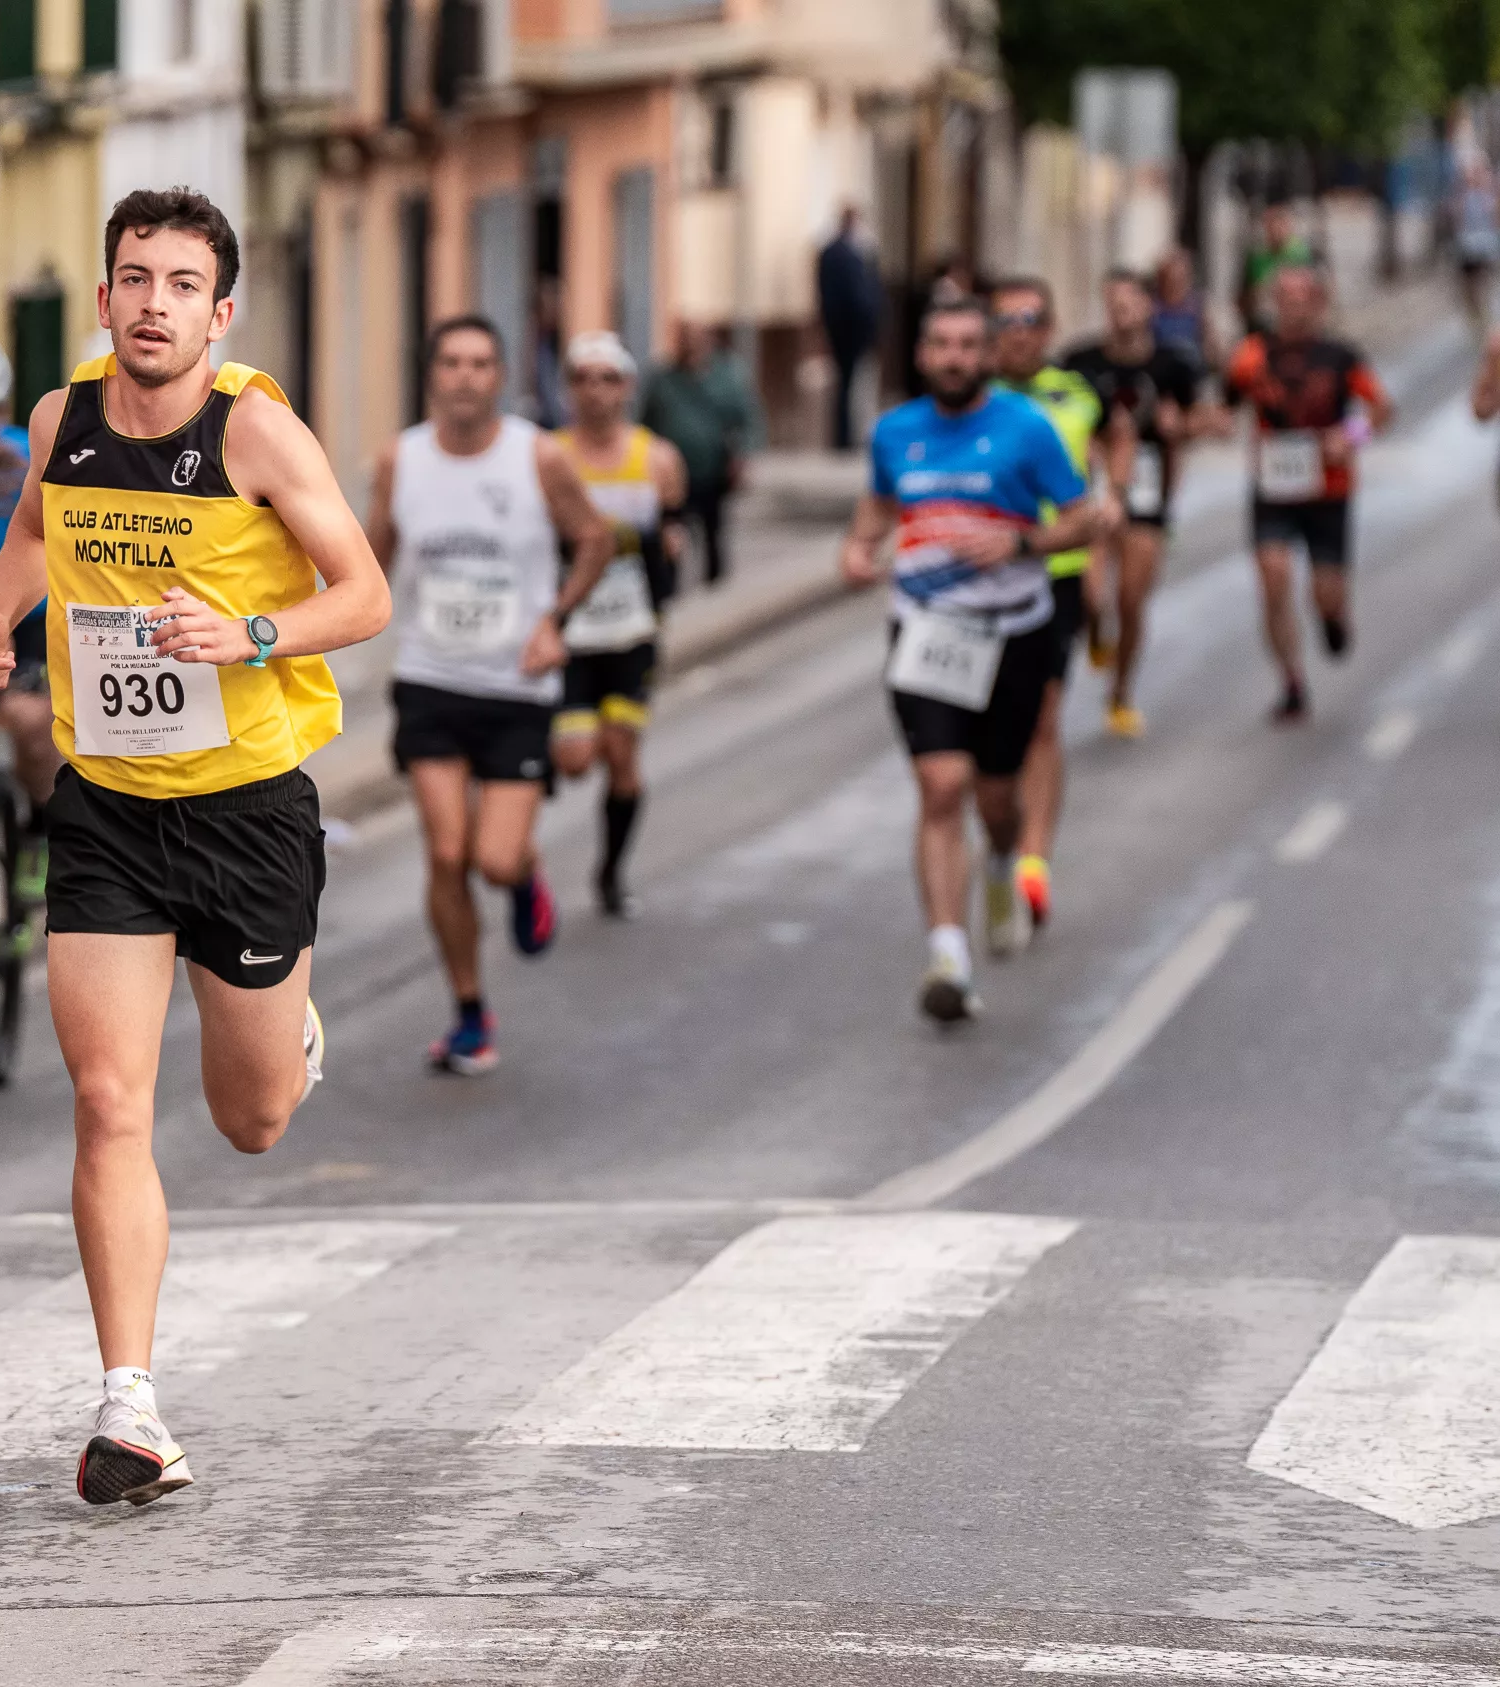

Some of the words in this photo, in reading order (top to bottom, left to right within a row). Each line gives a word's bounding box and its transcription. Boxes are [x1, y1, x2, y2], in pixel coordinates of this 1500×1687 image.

[63, 510, 97, 529] CLUB
[101, 512, 193, 536] ATLETISMO
[75, 539, 176, 568] MONTILLA
[72, 610, 91, 619] CIRCUITO
[92, 611, 121, 620] PROVINCIAL
[72, 617, 97, 626] CARRERAS
[98, 620, 132, 628] POPULARES
[100, 672, 184, 717] 930
[132, 727, 160, 735] BELLIDO
[161, 725, 185, 733] PEREZ
